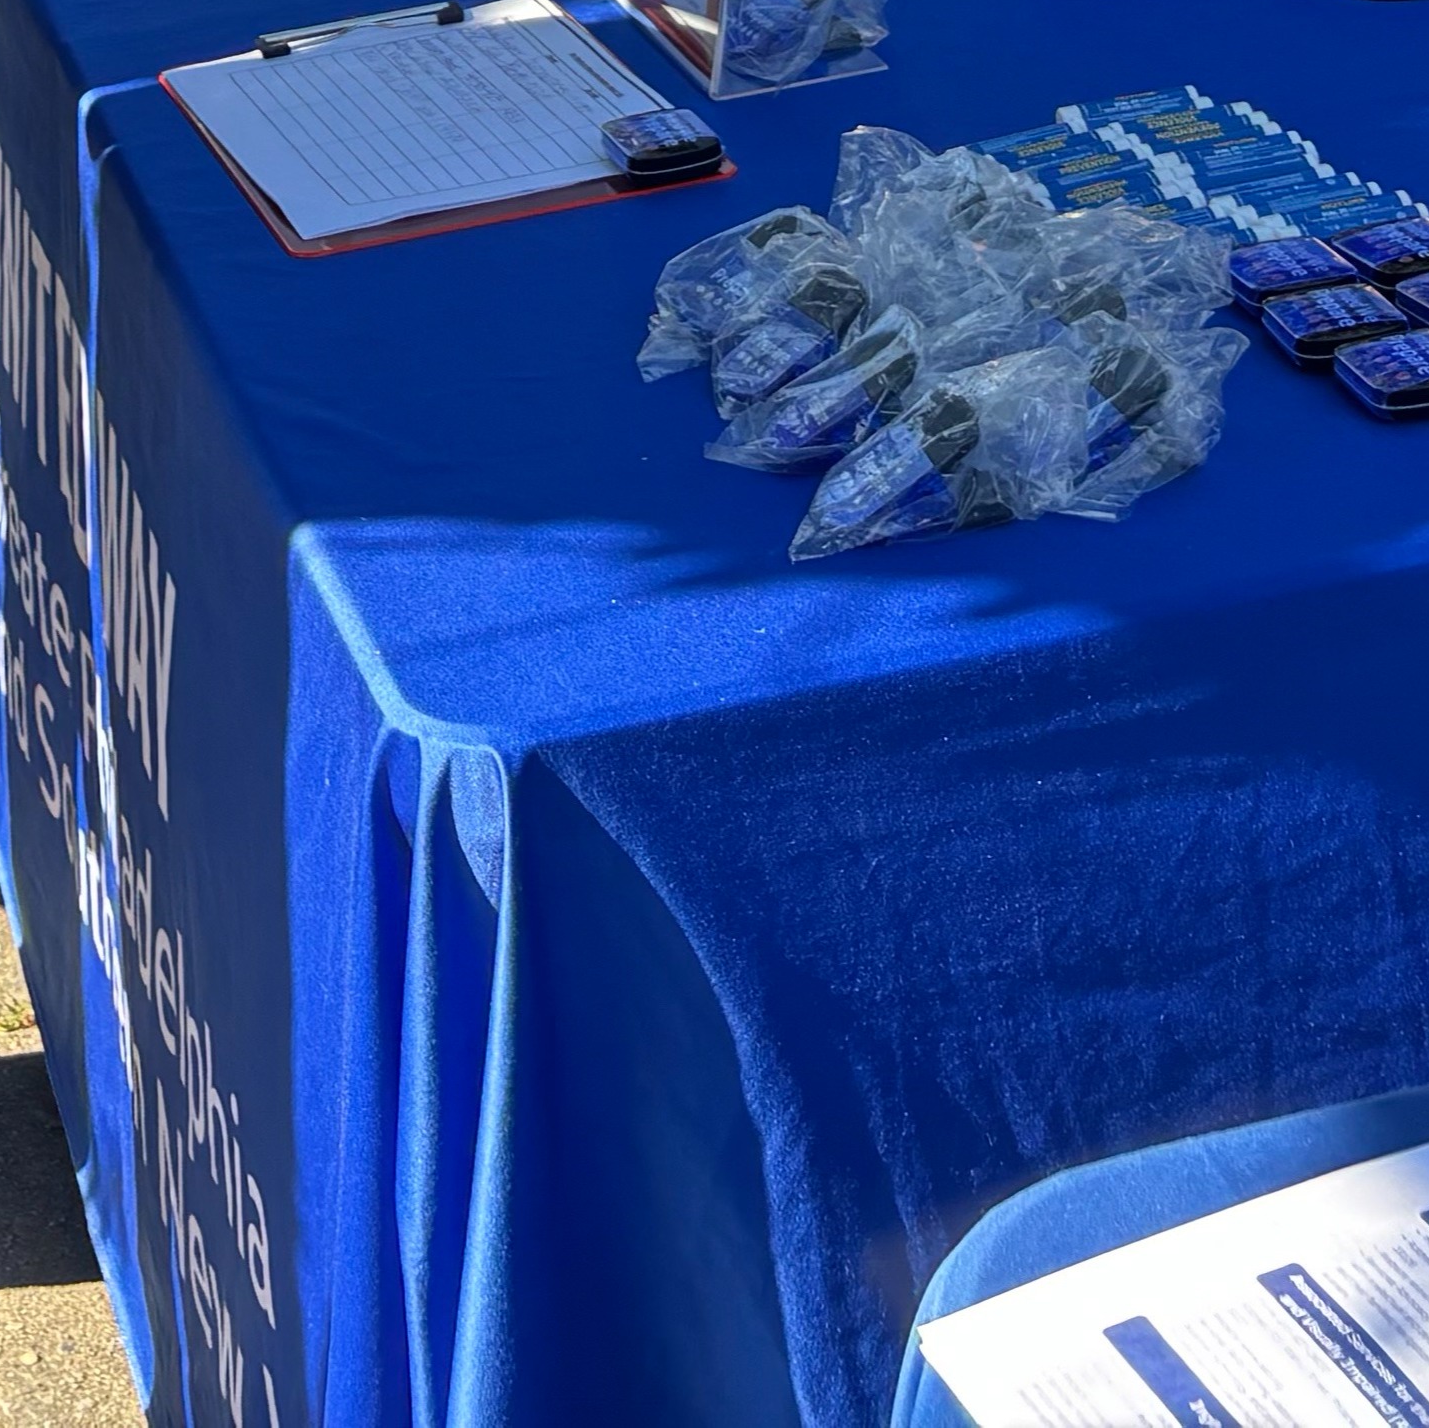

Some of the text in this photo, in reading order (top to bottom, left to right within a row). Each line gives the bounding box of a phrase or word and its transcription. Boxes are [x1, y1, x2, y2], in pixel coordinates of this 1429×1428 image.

[97, 388, 176, 822] WAY
[79, 628, 276, 1331] Philadelphia
[156, 1076, 243, 1428] New
[1392, 1385, 1414, 1402] for
